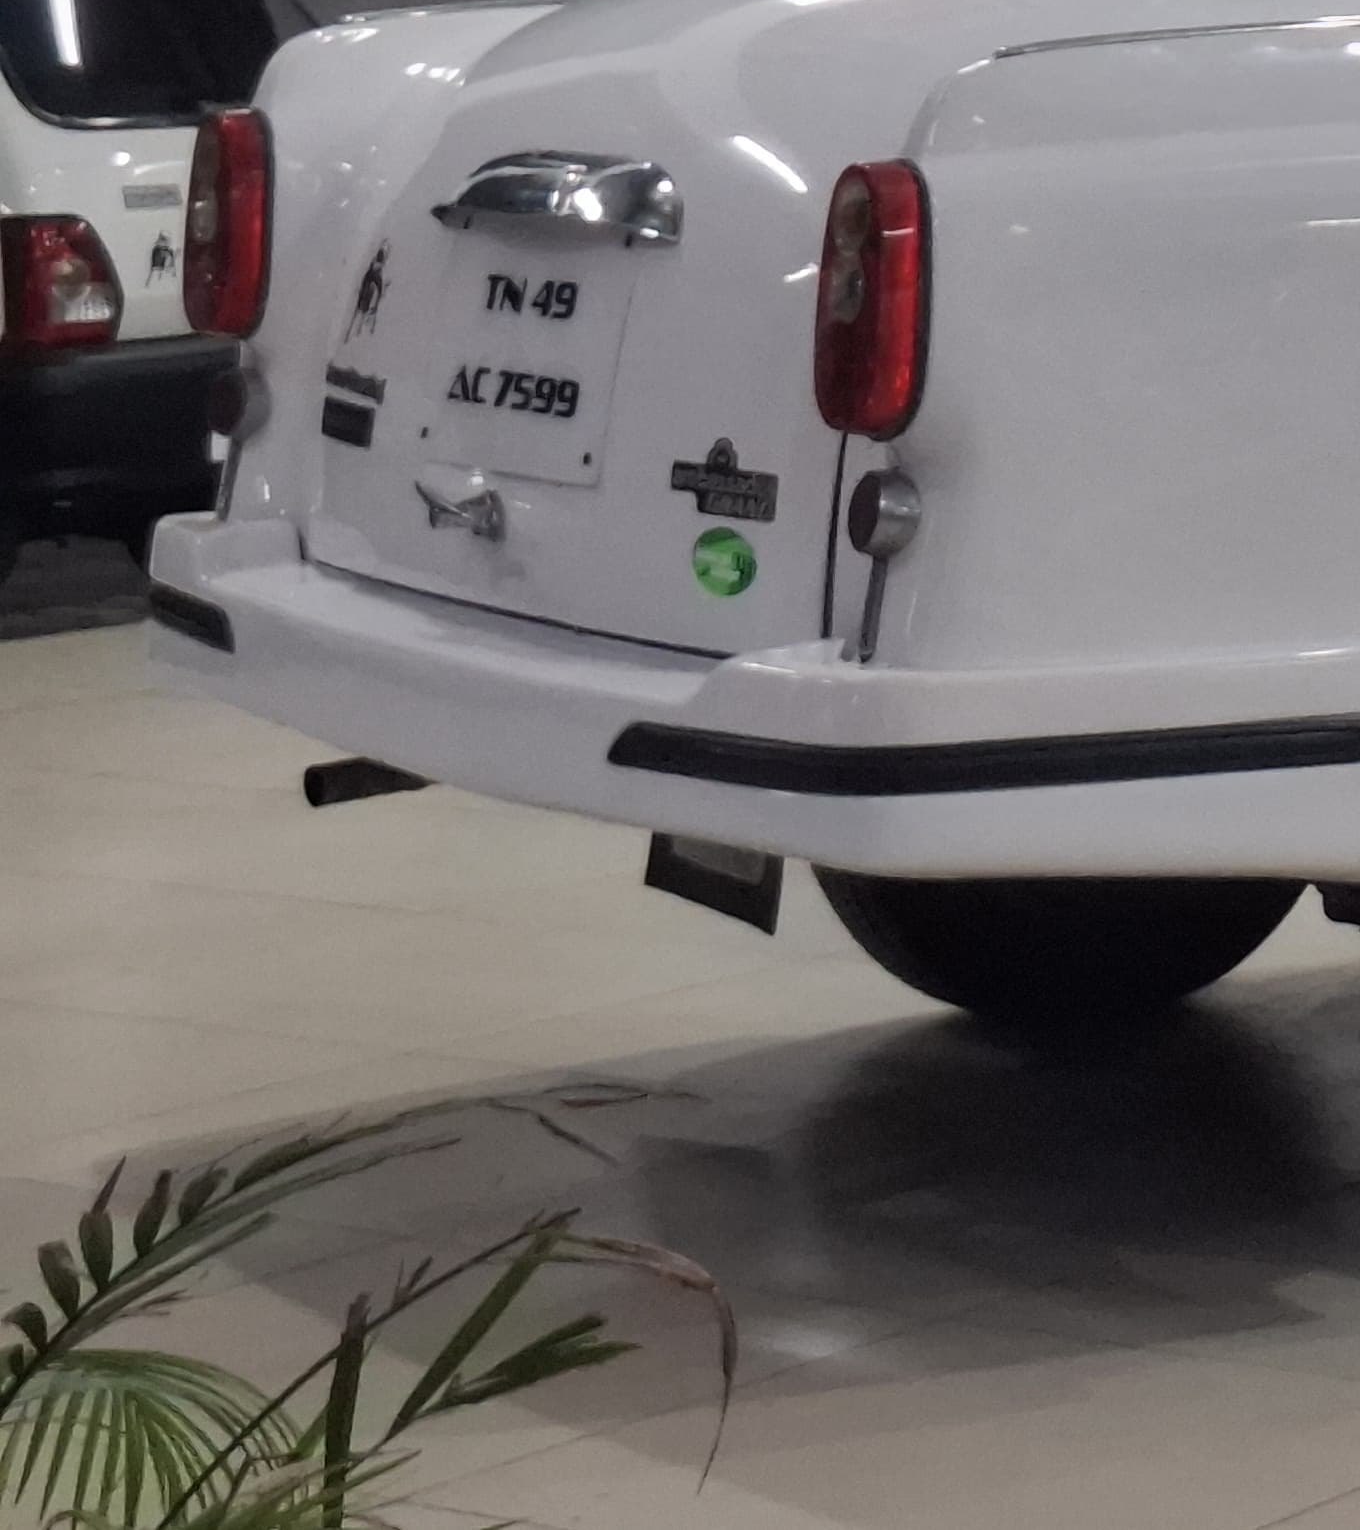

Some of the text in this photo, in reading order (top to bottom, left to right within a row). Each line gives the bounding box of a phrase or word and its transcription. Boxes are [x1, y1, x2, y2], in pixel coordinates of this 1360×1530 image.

[486, 273, 579, 320] TN 49
[447, 364, 580, 418] AC 7599
